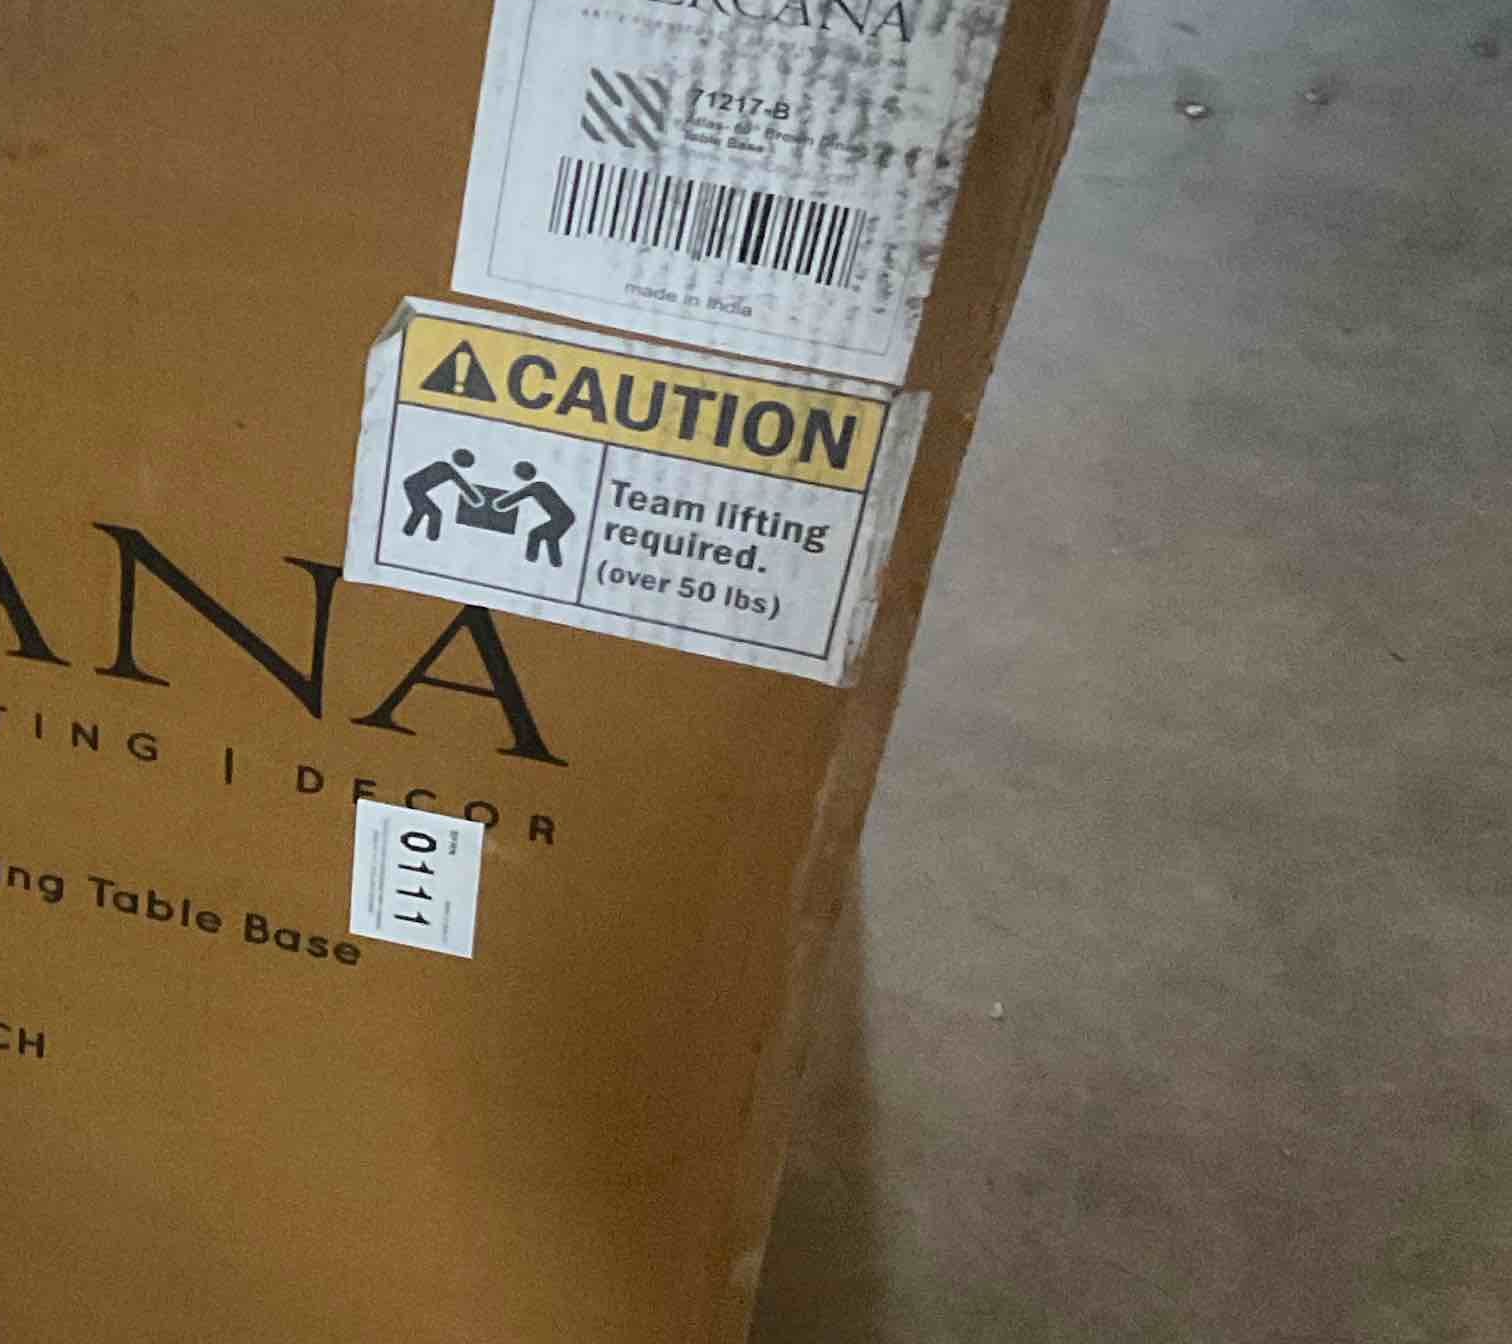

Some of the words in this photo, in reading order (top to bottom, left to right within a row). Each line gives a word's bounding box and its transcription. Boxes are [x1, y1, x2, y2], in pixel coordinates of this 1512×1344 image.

[690, 88, 790, 120] 71217-B
[624, 281, 678, 304] made
[683, 293, 700, 307] in
[506, 353, 857, 470] CAUTION
[604, 519, 769, 574] required.
[608, 479, 707, 524] Team
[715, 500, 830, 554] lifting
[595, 558, 671, 596] (over
[677, 574, 716, 604] 50
[724, 582, 782, 621] lbs)
[393, 830, 438, 928] 0111
[87, 875, 223, 935] Table
[243, 912, 362, 967] Base
